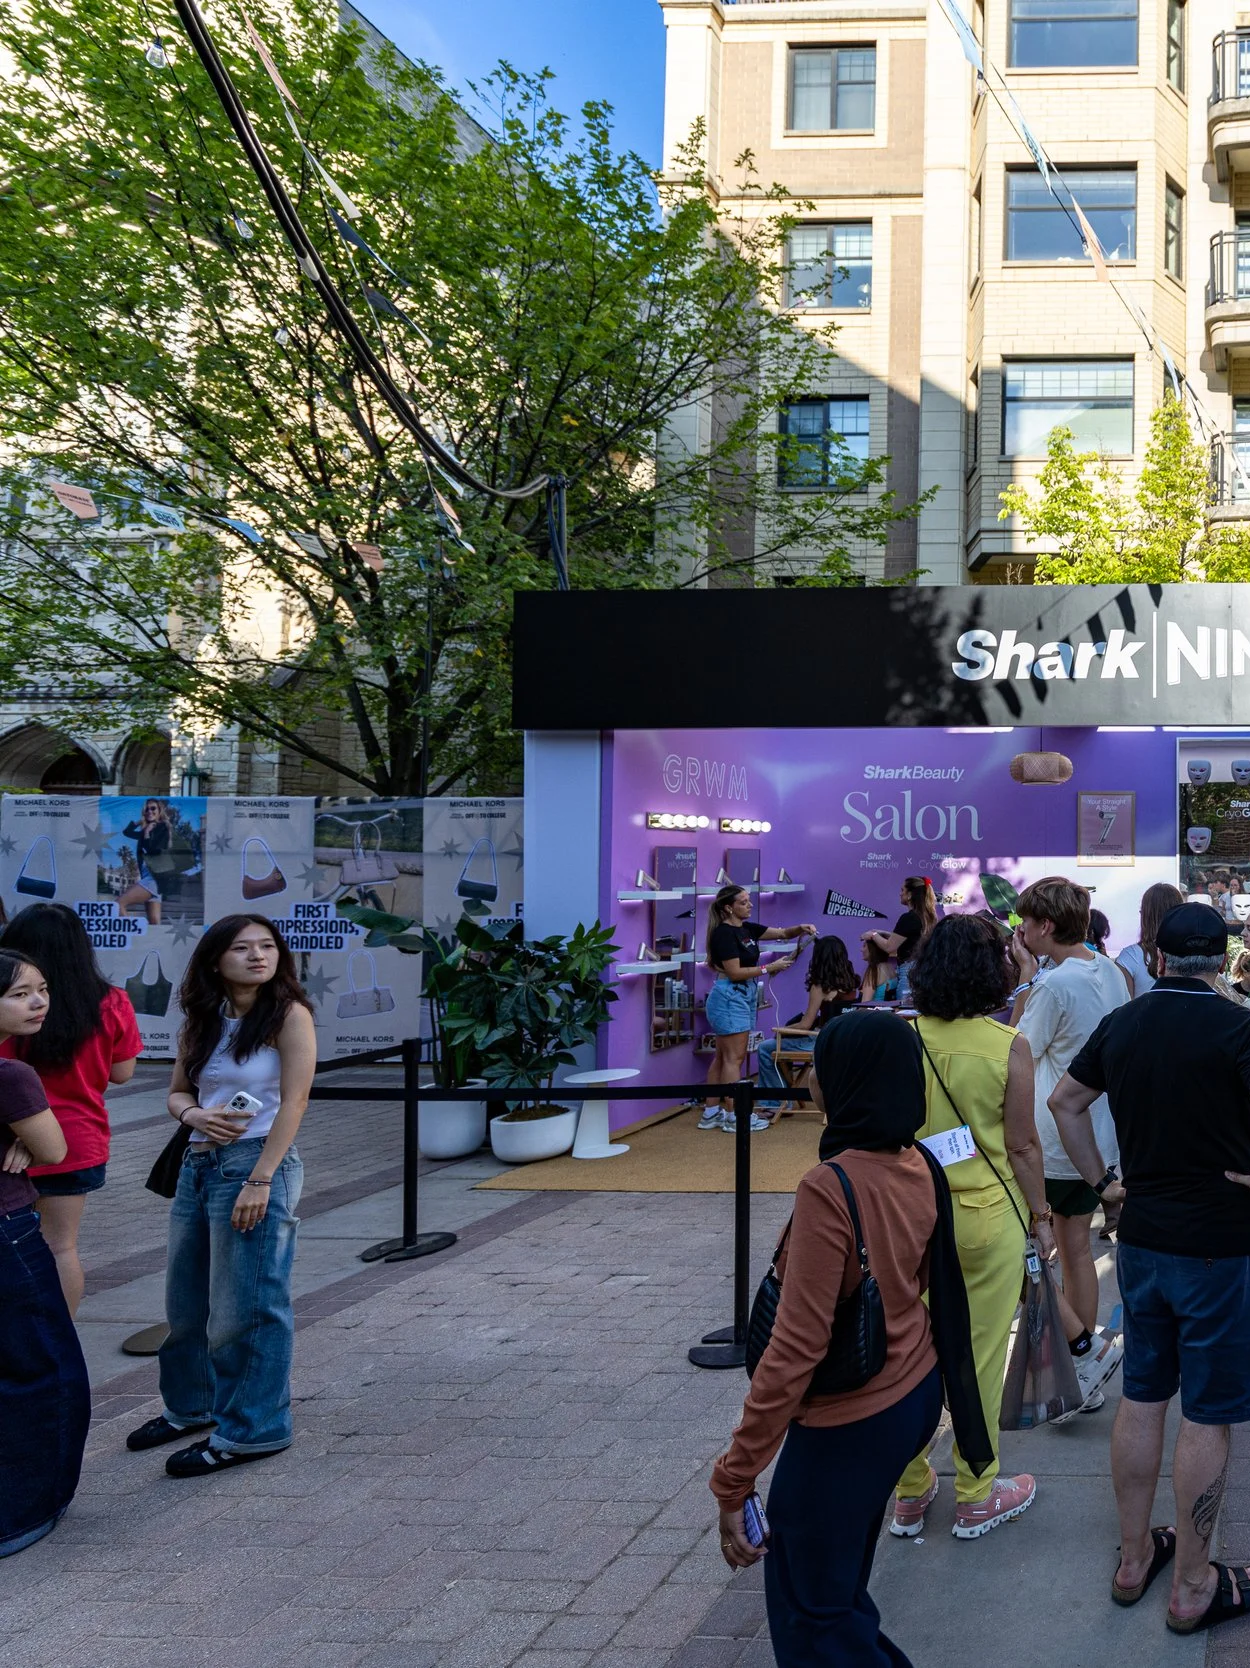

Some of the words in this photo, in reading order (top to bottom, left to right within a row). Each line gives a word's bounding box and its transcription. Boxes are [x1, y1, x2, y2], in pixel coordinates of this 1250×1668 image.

[952, 629, 1146, 680] Shark
[663, 754, 748, 800] GRWM
[863, 765, 964, 783] SharkBeauty
[840, 790, 983, 843] Salon
[79, 903, 114, 917] FIRST
[294, 904, 330, 918] FIRST
[81, 918, 142, 934] RESSIONS,
[273, 920, 359, 935] MPRESSIONS,
